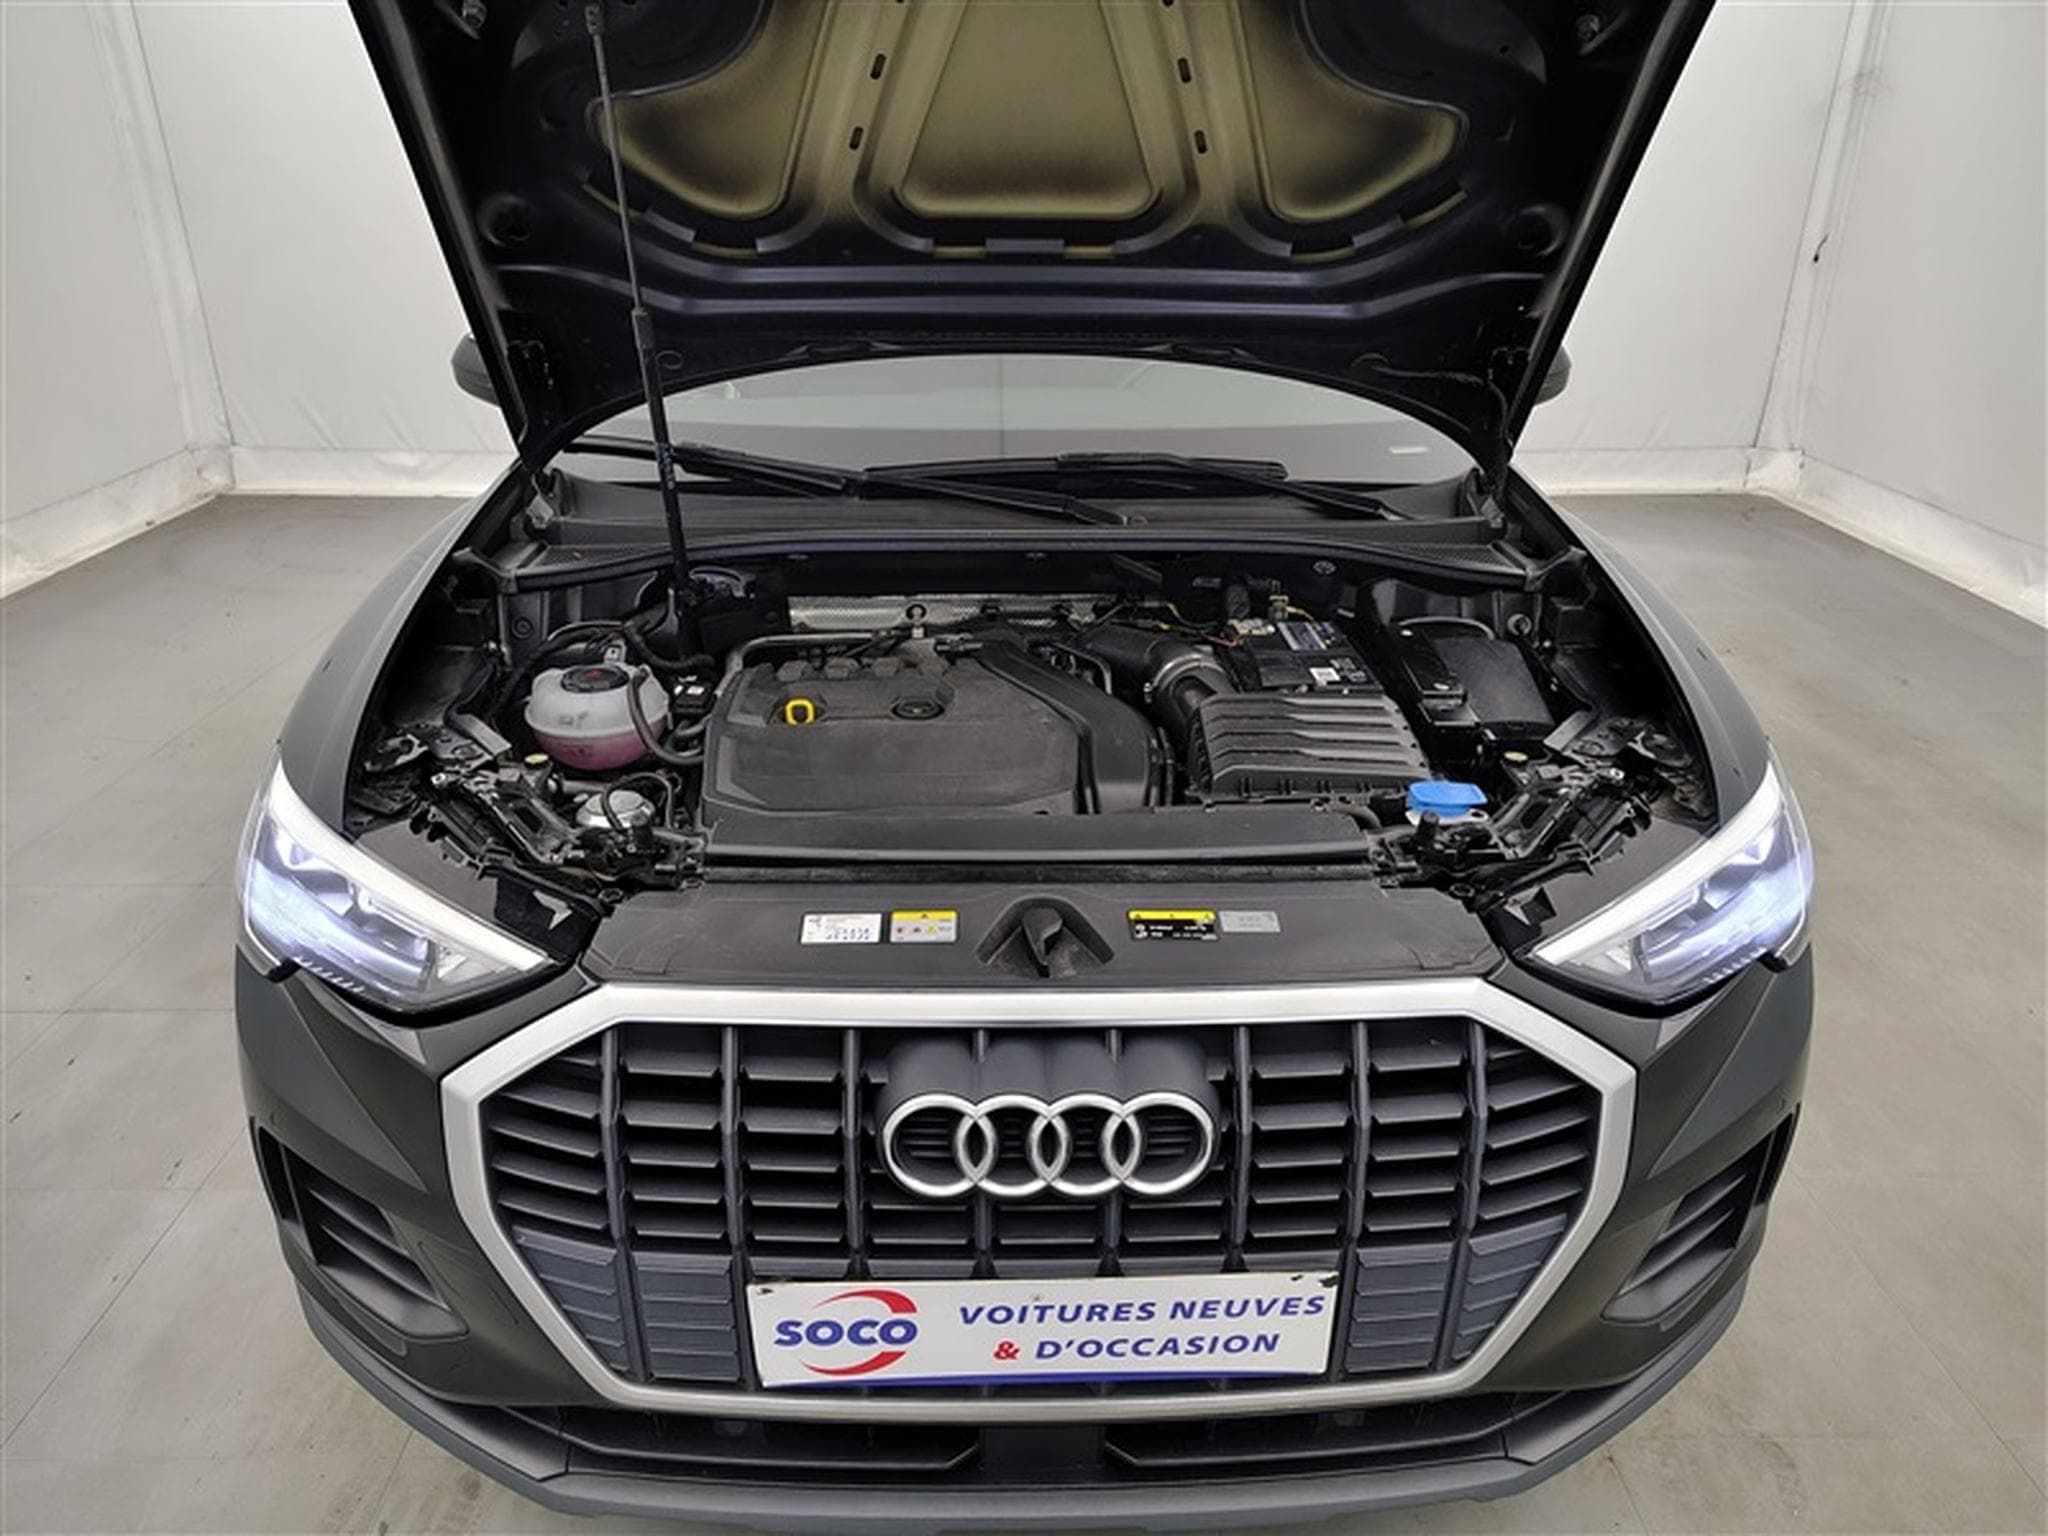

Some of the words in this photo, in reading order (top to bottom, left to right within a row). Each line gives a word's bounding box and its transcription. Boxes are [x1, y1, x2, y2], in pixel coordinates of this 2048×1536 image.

[960, 1301, 1156, 1325] VOITURES
[1168, 1295, 1325, 1320] NEUVES
[774, 1318, 917, 1346] SOCO
[993, 1340, 1020, 1361] &
[1034, 1333, 1280, 1360] D'OCCASION
